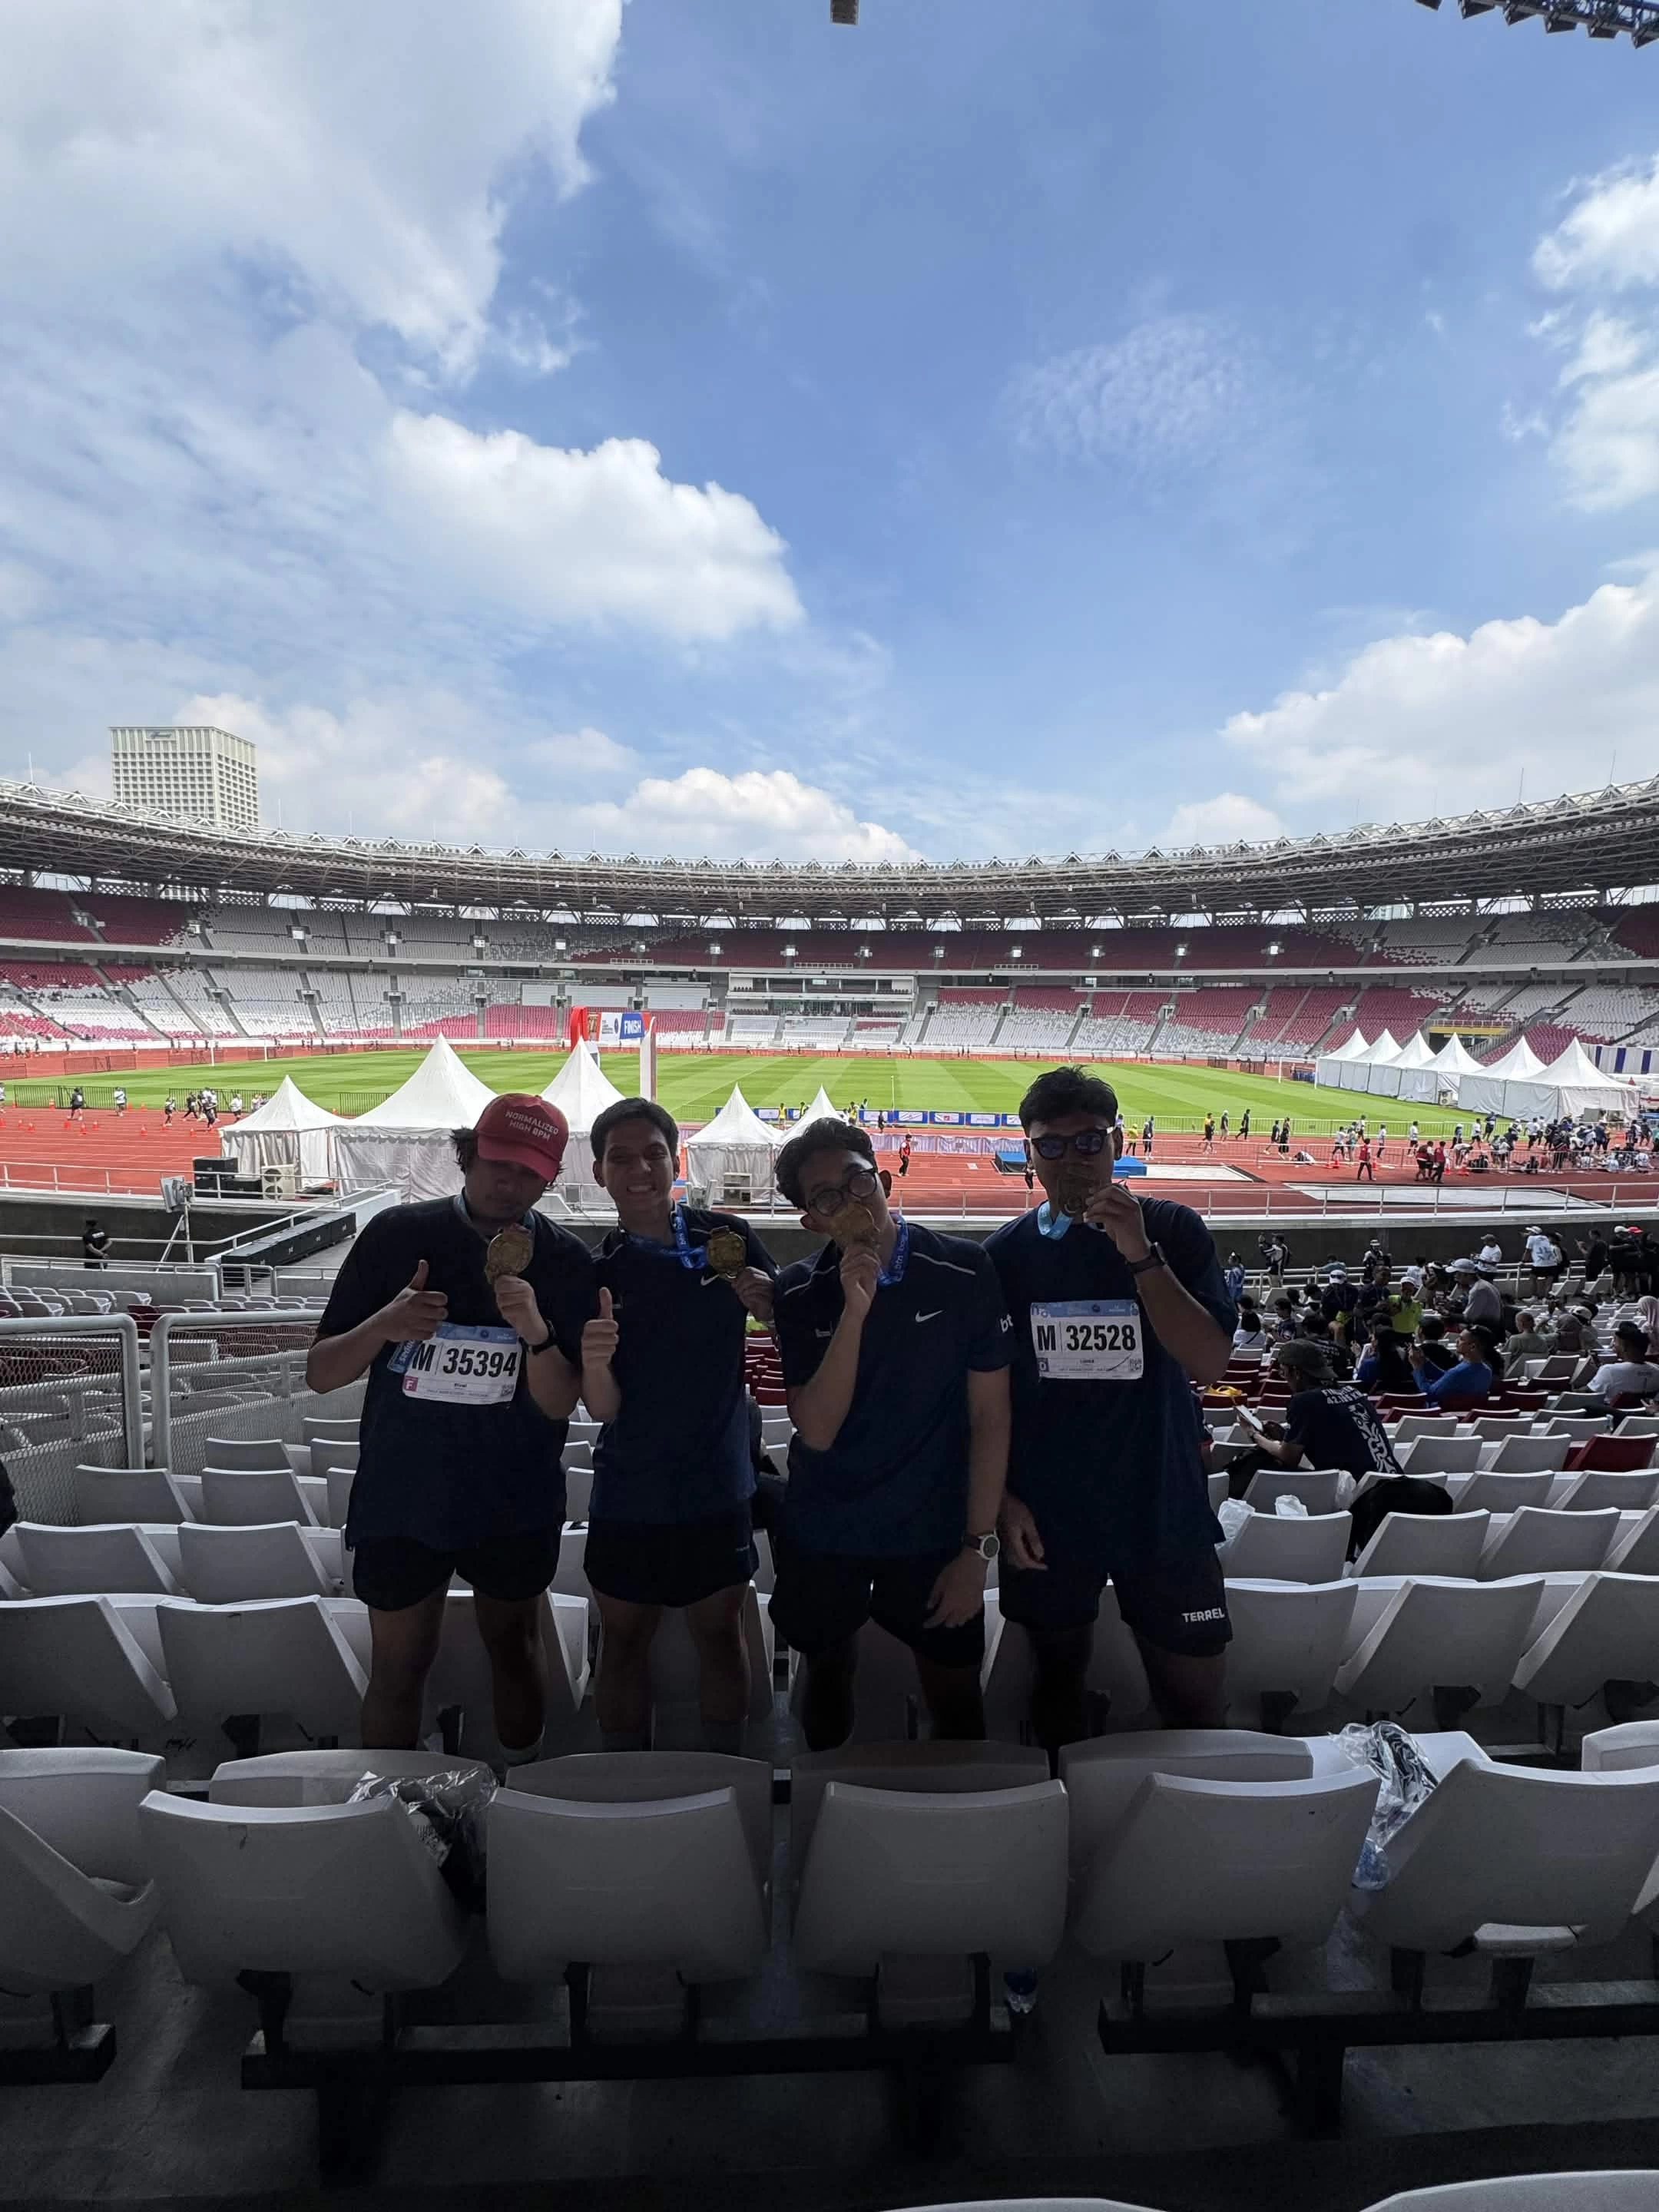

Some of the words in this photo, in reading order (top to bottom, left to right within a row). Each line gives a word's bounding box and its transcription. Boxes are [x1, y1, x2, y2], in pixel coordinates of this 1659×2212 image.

[624, 1019, 642, 1035] FINISH
[505, 1111, 559, 1135] NORMALIZED
[509, 1120, 531, 1132] HIGH
[531, 1127, 551, 1142] BPM
[1037, 1325, 1056, 1351] M
[1066, 1324, 1136, 1352] 32528
[412, 1343, 436, 1373] M
[442, 1347, 518, 1379] 35394
